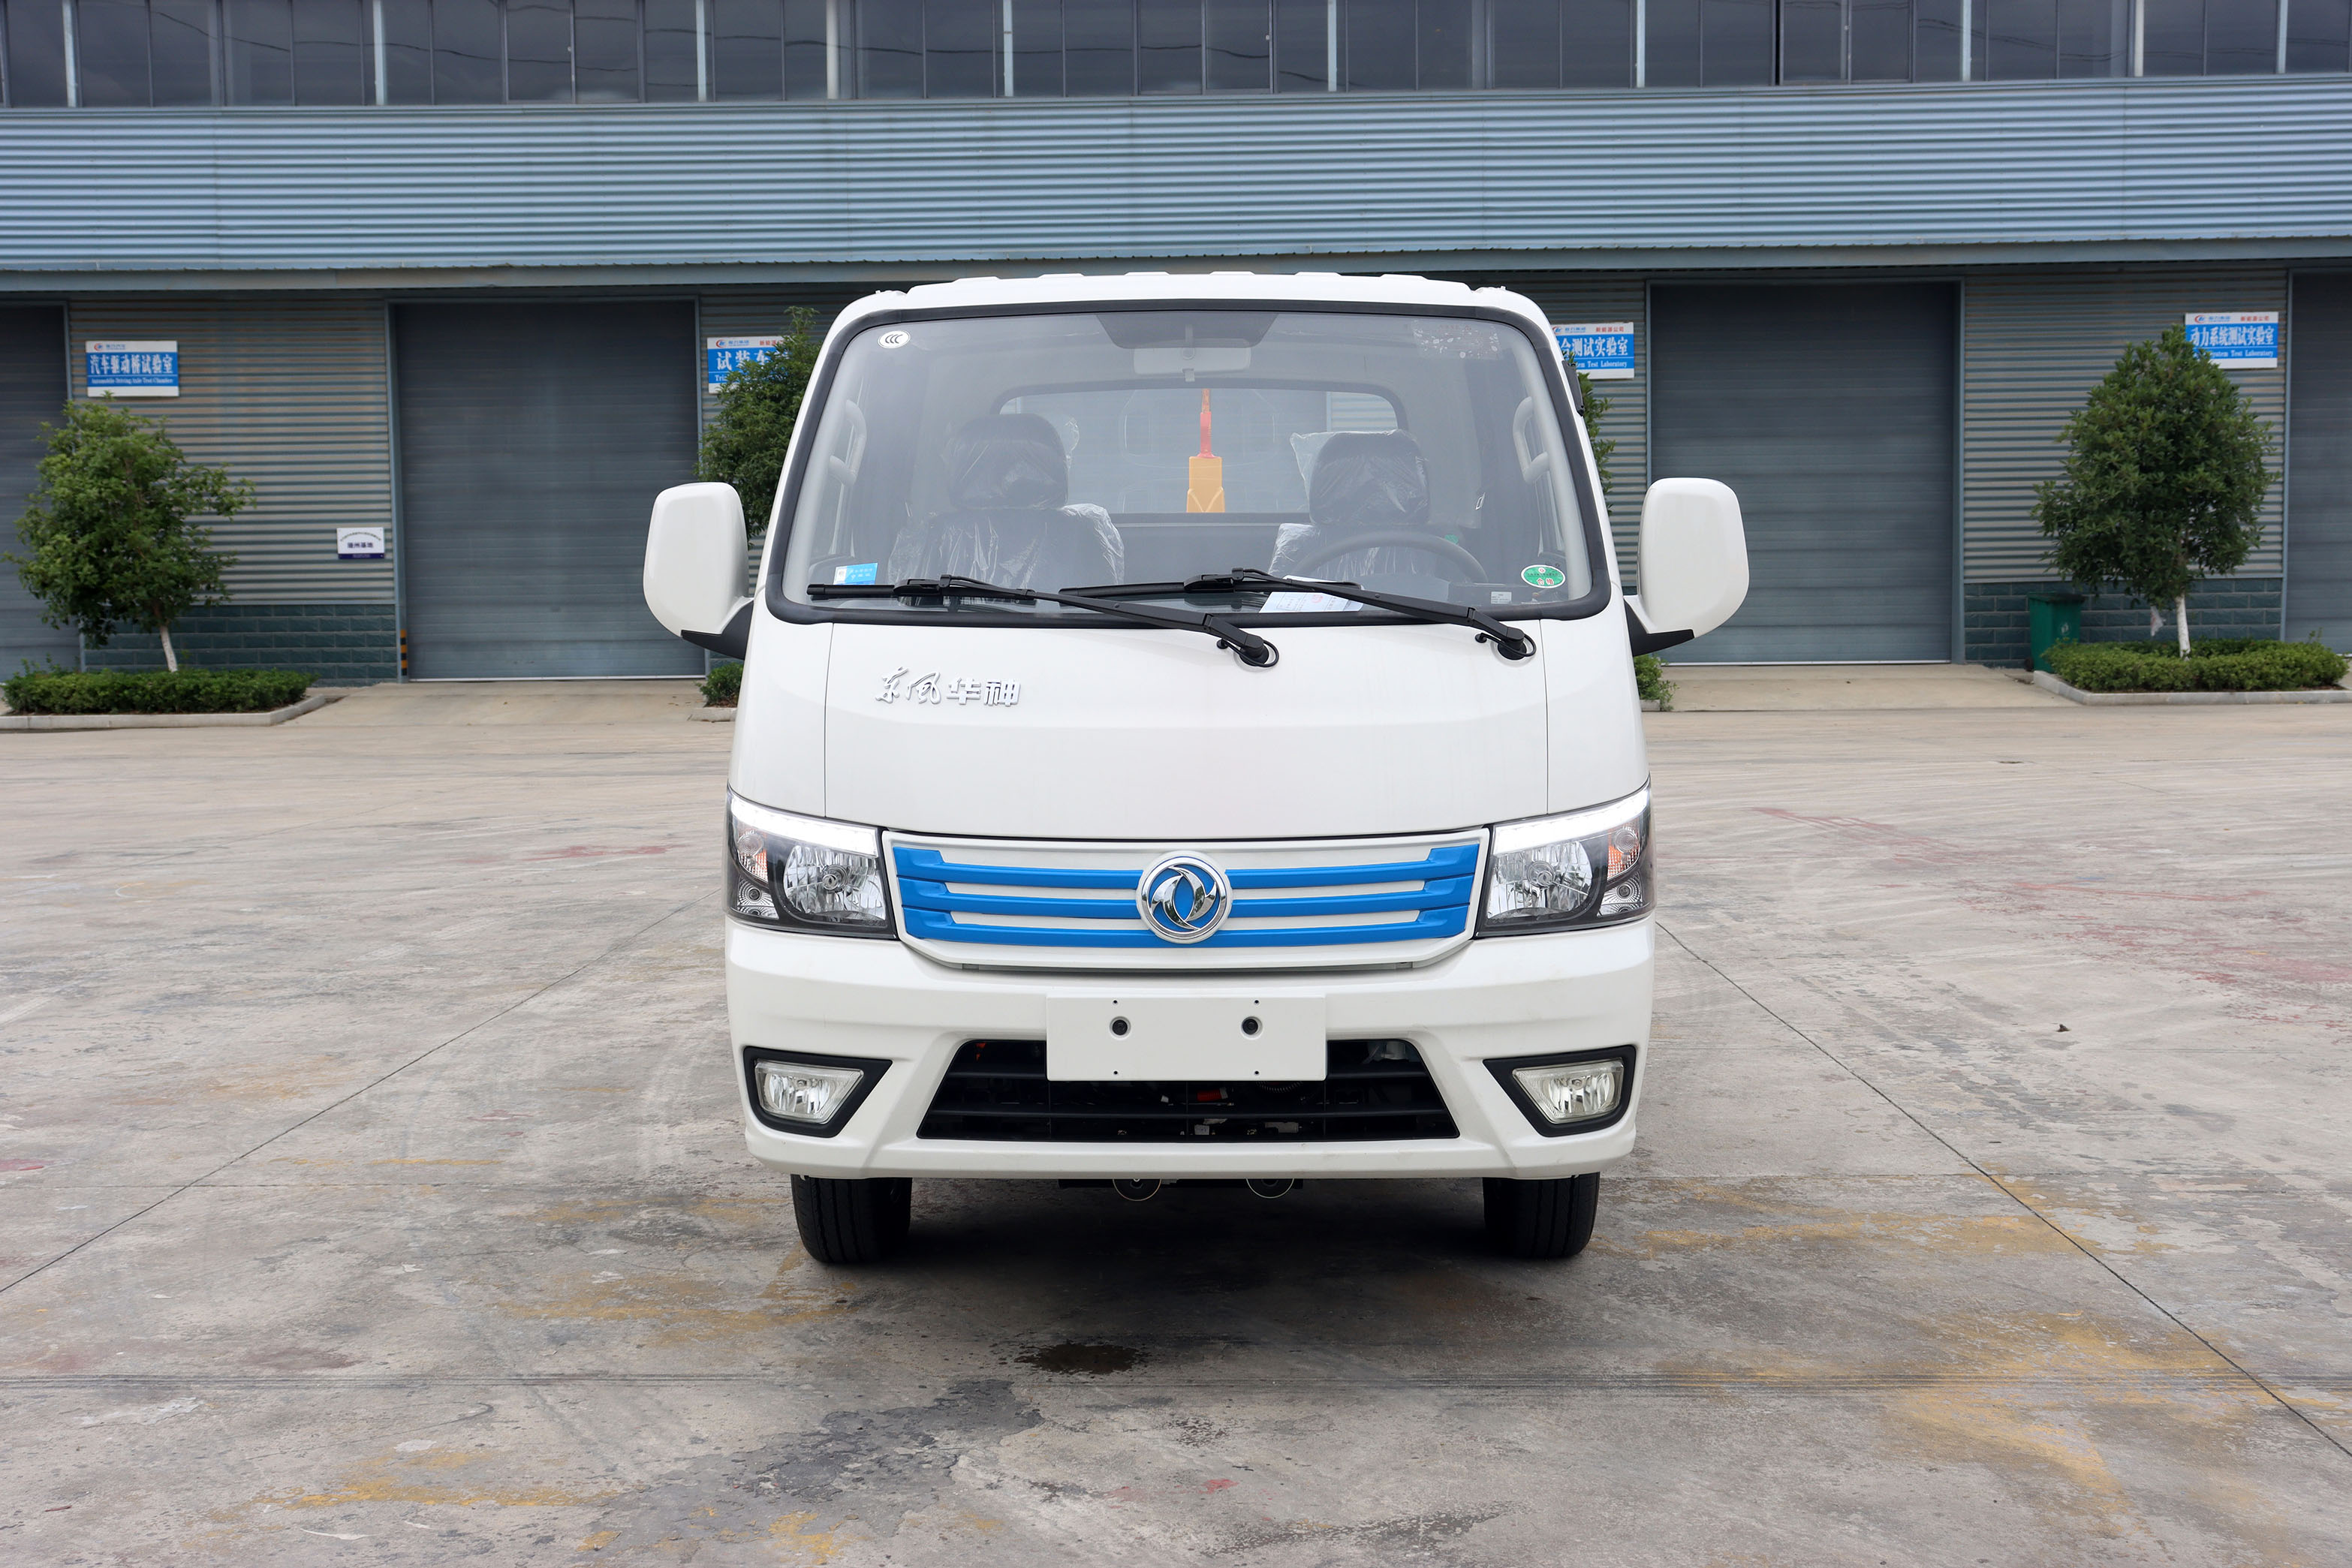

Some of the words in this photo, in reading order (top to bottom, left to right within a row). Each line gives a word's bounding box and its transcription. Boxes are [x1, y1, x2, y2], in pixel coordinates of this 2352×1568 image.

[1557, 336, 1628, 357] 合测试实验室
[2190, 326, 2275, 347] 动力系统测试实验室
[2245, 349, 2274, 358] Laboratory
[90, 354, 173, 375] 汽车驱动桥试验室
[1601, 360, 1628, 369] Laboratory
